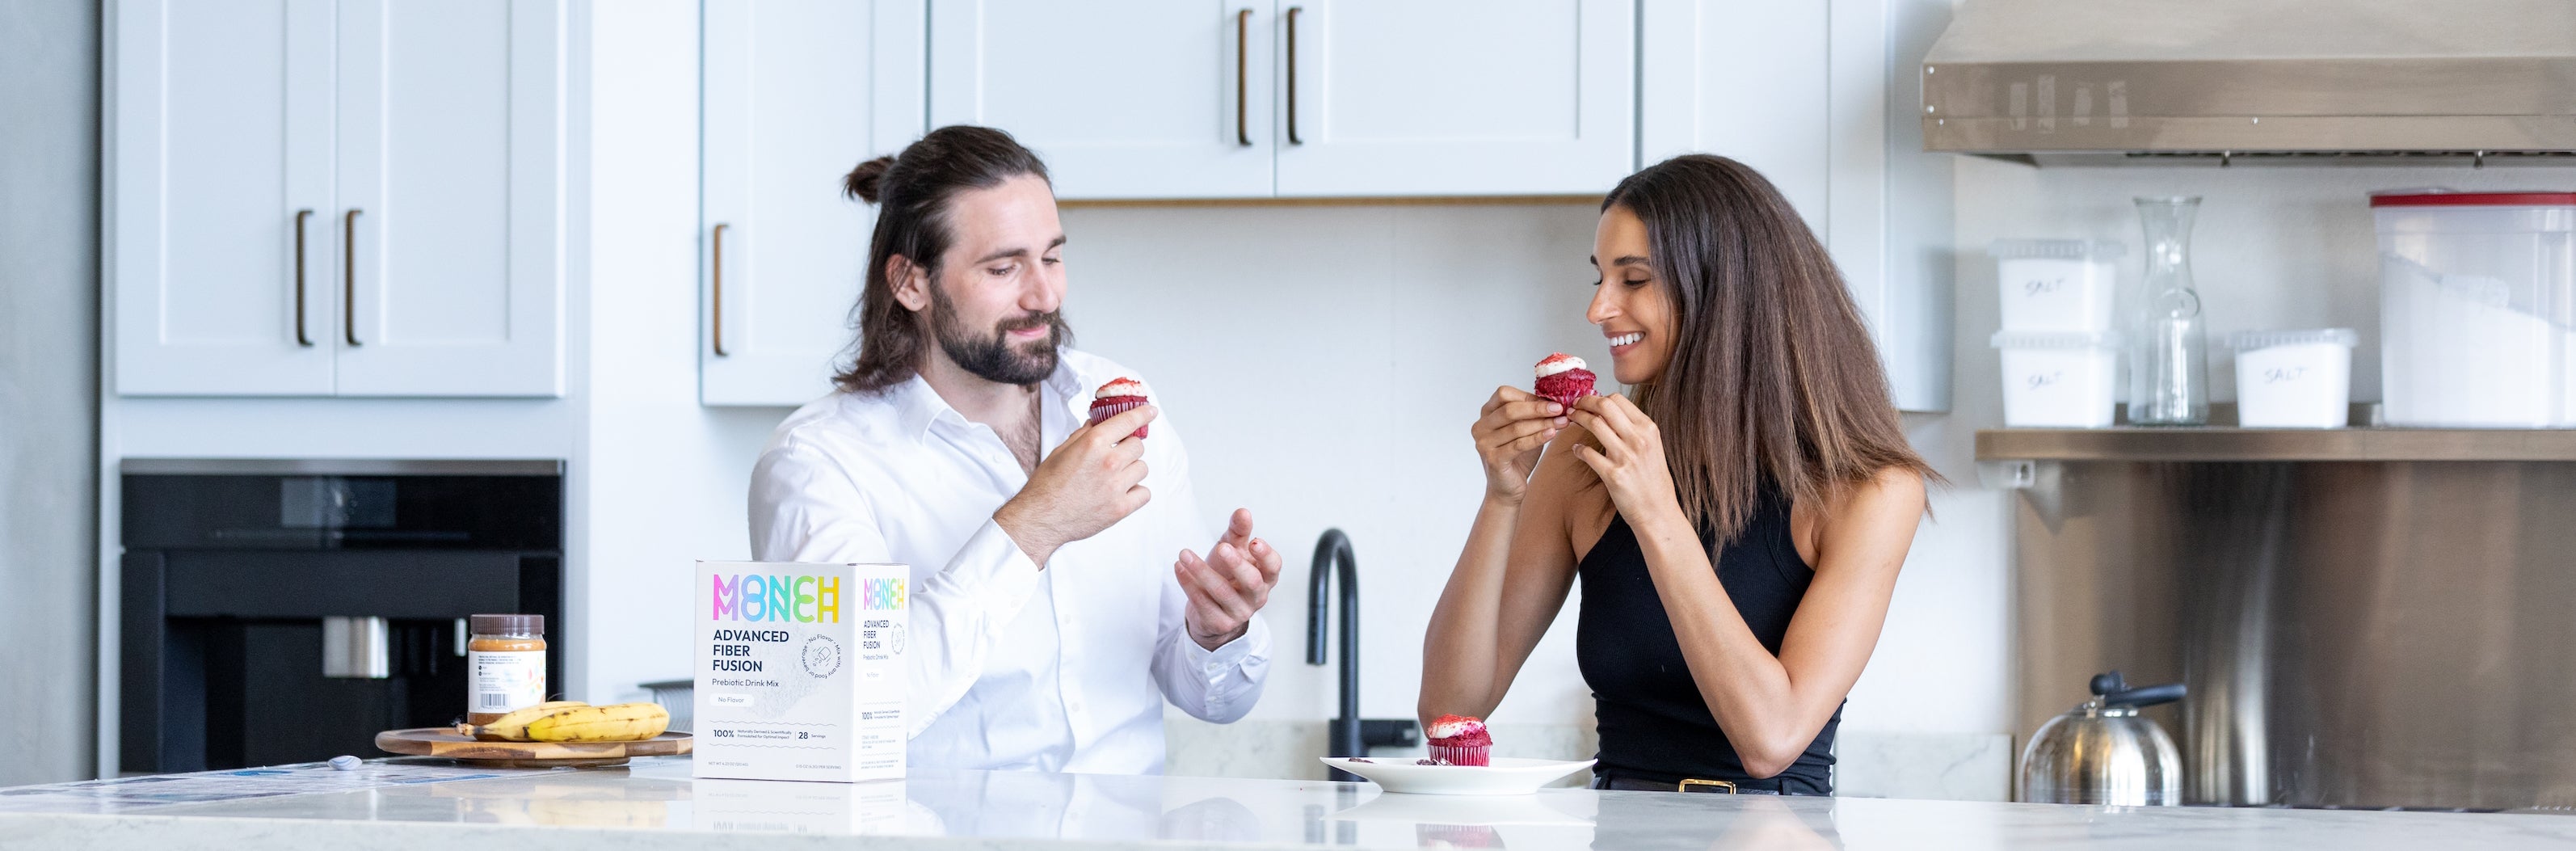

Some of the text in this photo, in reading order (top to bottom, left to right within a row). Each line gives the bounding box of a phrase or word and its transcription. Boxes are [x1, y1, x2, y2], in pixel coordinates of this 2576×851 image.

[2025, 278, 2065, 296] SALT
[2027, 371, 2064, 390] SALT
[2264, 366, 2309, 385] SALT
[864, 620, 890, 628] ADVANCED
[713, 629, 789, 642] ADVANCED
[863, 630, 877, 638] FIBER
[713, 644, 751, 656] FIBER
[863, 641, 881, 649] FUSION
[817, 634, 833, 642] Flavor
[828, 668, 836, 676] any
[713, 659, 763, 672] FUSION
[712, 678, 779, 687] Prebiotic Drink Mix
[713, 729, 734, 738] 100%
[798, 731, 809, 739] 28
